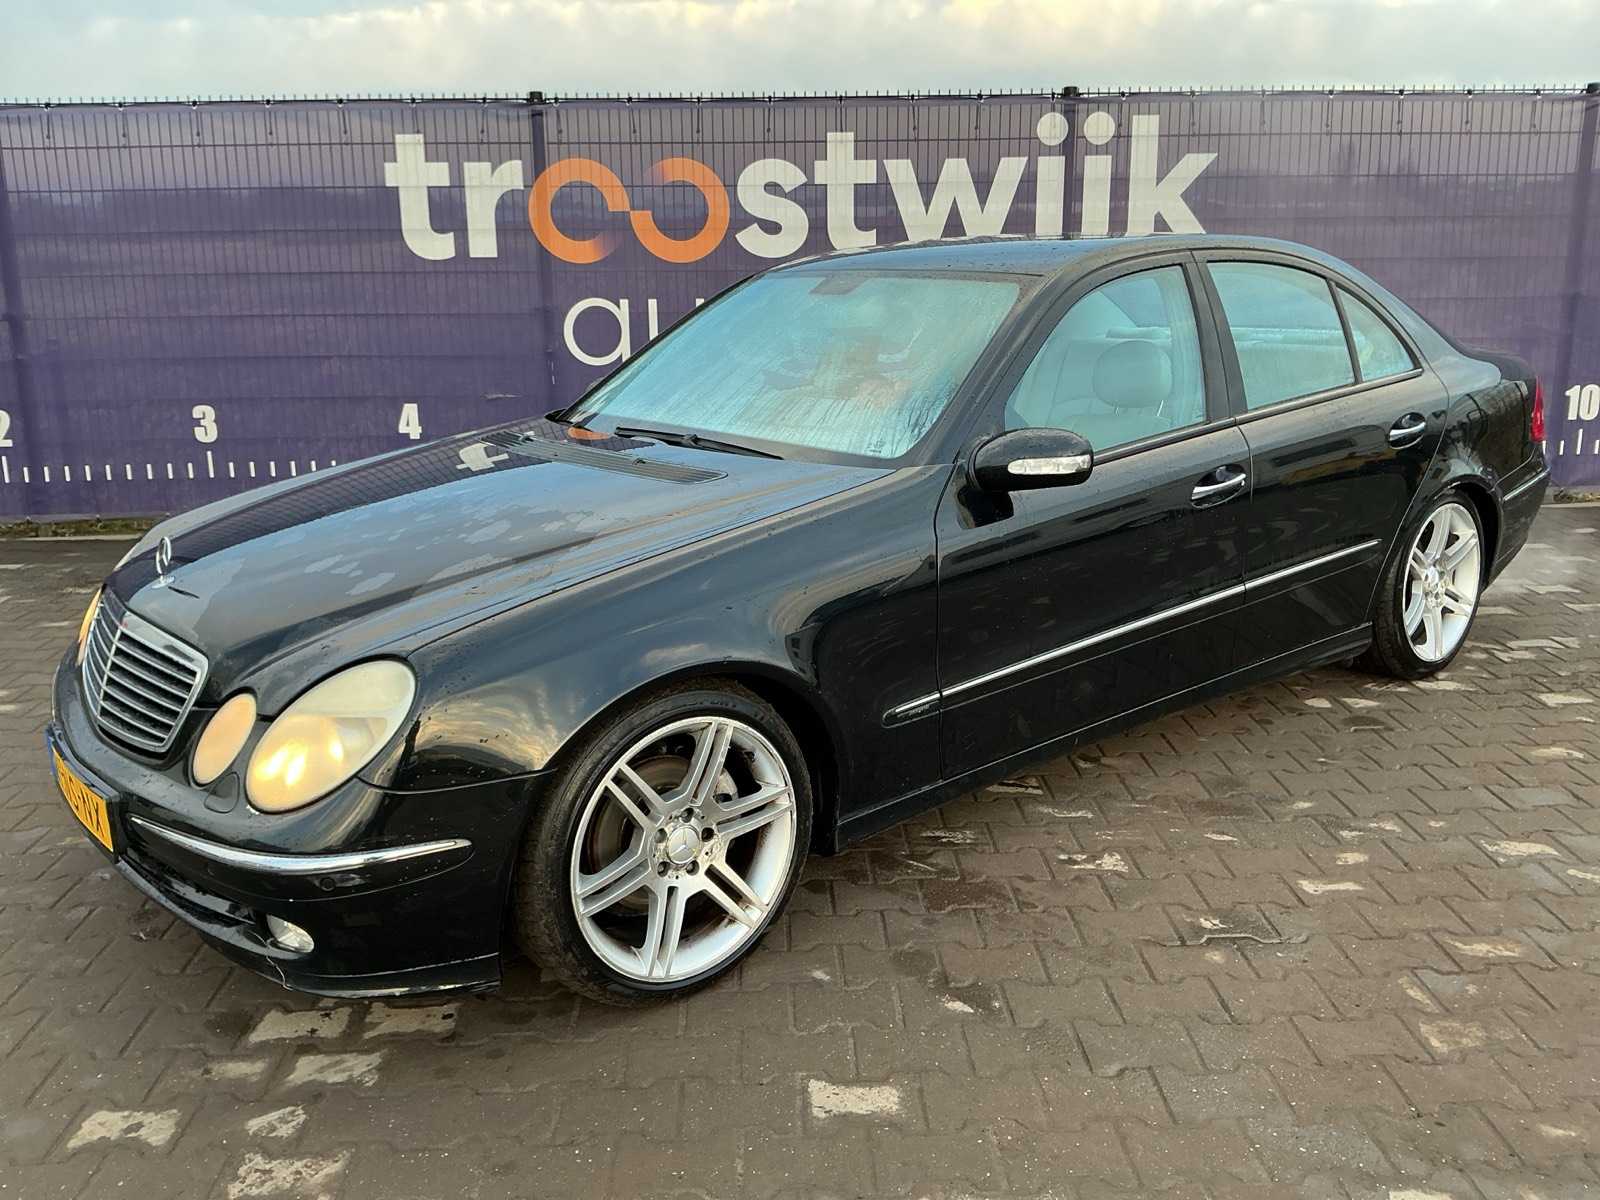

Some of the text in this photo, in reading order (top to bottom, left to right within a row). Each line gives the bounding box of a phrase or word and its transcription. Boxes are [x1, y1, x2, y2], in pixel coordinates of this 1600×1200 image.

[384, 111, 1218, 264] troostwijk
[397, 402, 423, 441] 4
[1565, 383, 1600, 421] 10
[191, 404, 219, 444] 3
